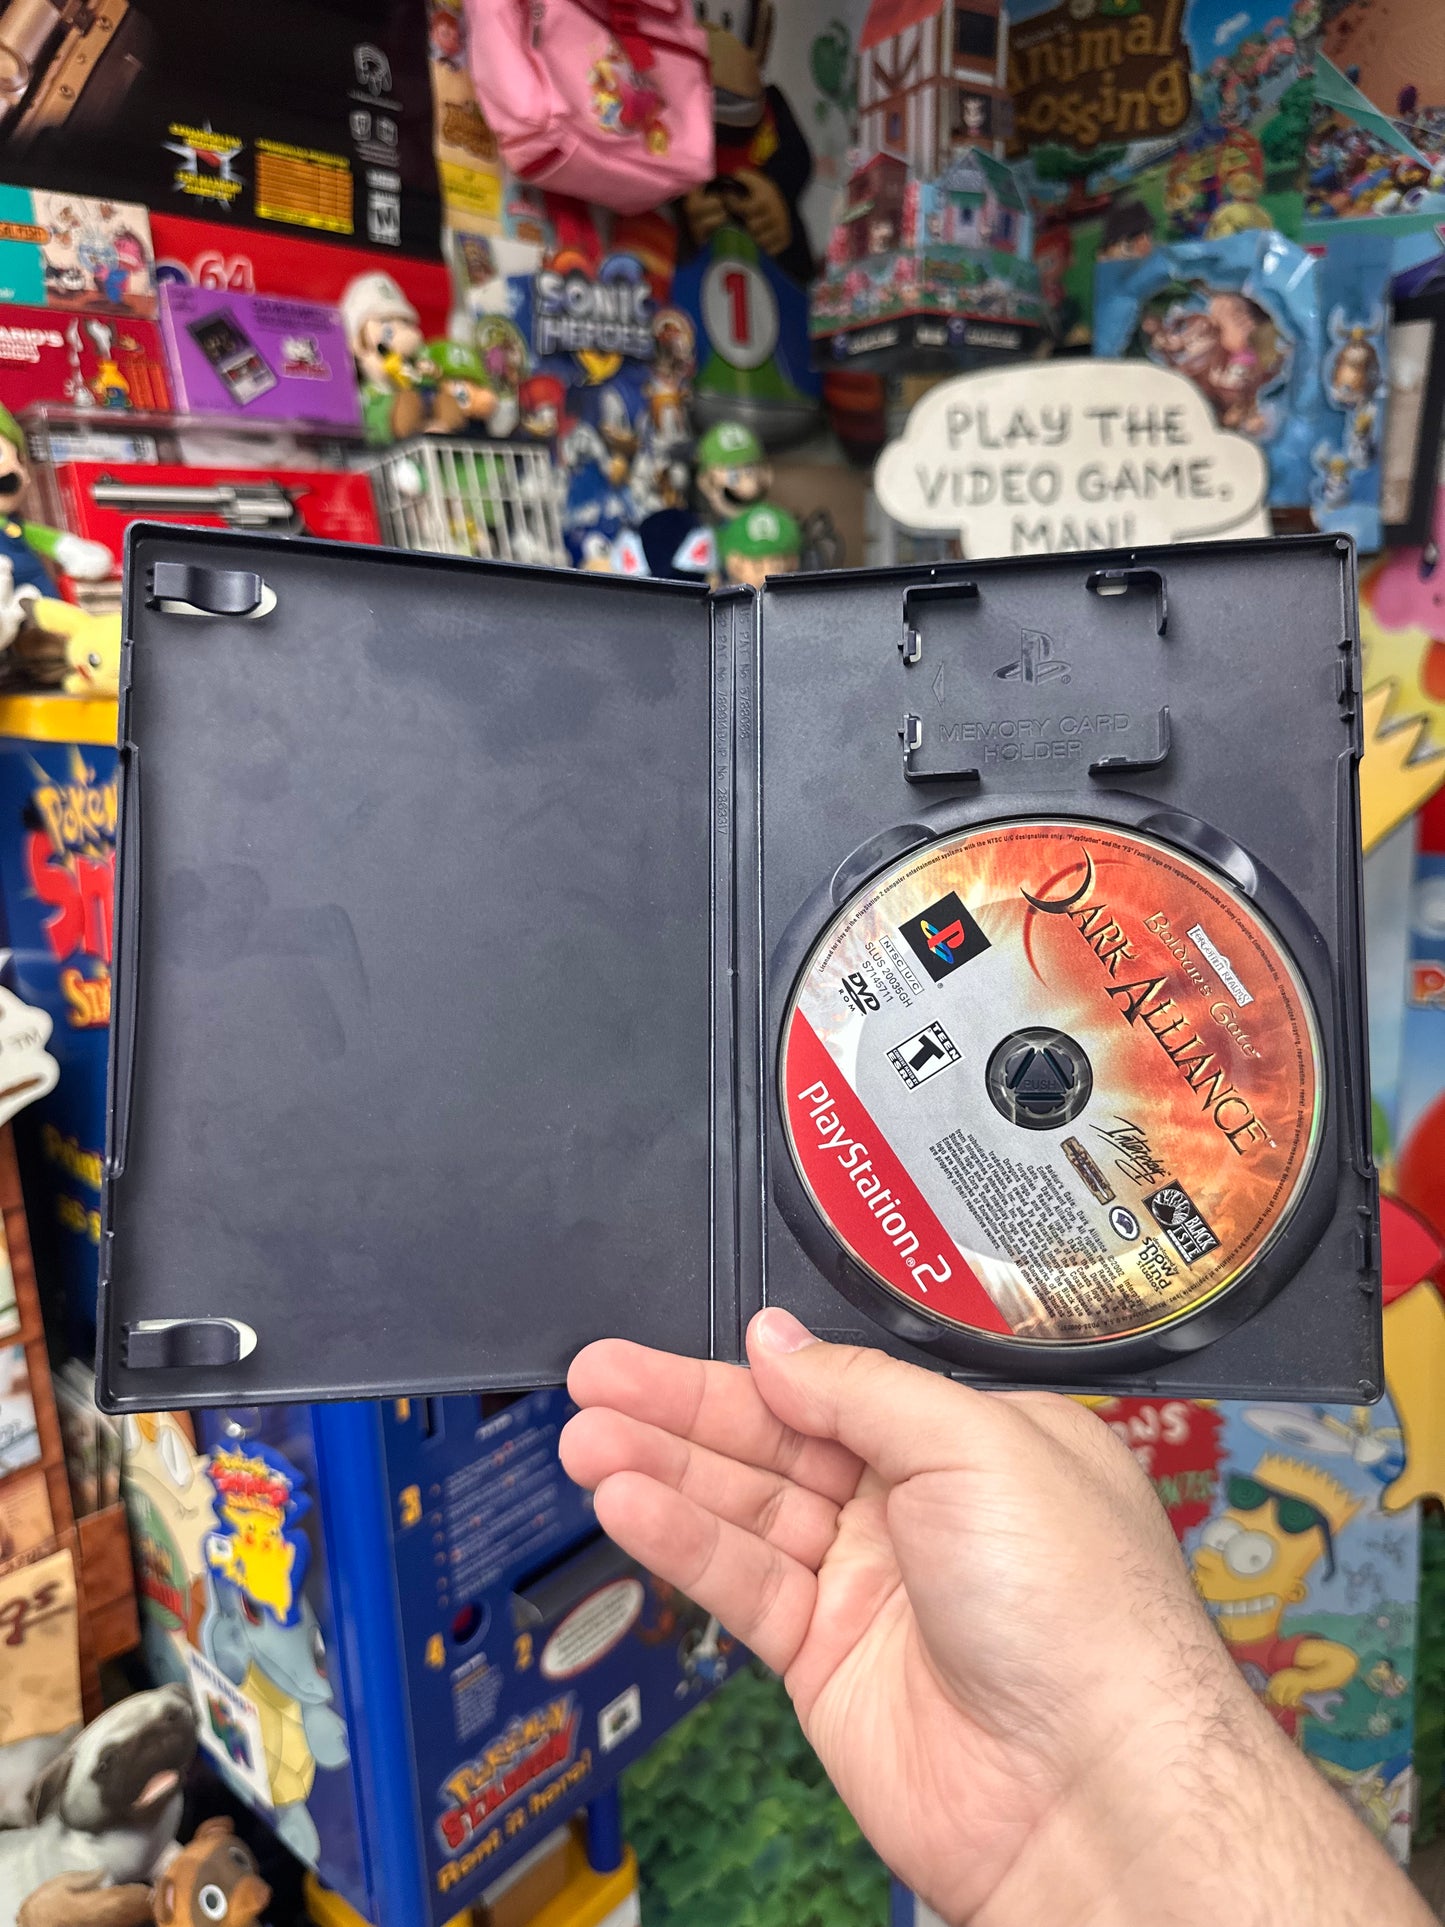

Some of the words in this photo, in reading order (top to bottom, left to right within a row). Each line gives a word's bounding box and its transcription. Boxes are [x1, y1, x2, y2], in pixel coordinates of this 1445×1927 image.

[1012, 58, 1188, 146] ossing
[536, 271, 653, 320] SONIC
[945, 402, 1072, 450] PLAY
[1083, 402, 1192, 448] THE
[915, 462, 1062, 508] VIDEO
[938, 719, 1052, 743] MEMORY
[1058, 713, 1130, 736] CARD
[983, 739, 1083, 763] HOLDER
[817, 949, 834, 973] Licensed
[830, 941, 839, 951] for
[835, 931, 847, 944] play
[848, 917, 858, 927] the
[854, 893, 881, 919] PlayStation
[882, 874, 906, 894] computer
[904, 854, 941, 878] entertainment
[940, 846, 963, 860] systems
[962, 842, 976, 851] with
[975, 839, 986, 847] the
[986, 835, 1003, 845] NTSC
[1014, 831, 1048, 841] designation
[1100, 838, 1112, 847] and
[1111, 841, 1121, 849] the
[1150, 856, 1164, 867] logo
[1162, 863, 1172, 871] are
[1170, 867, 1197, 886] registered
[1194, 882, 1222, 905] trademarks
[862, 960, 894, 1003] S7145711
[865, 942, 886, 968] SLUS
[882, 967, 913, 1008] 20035GH
[884, 941, 905, 968] NTSC
[904, 970, 920, 991] U/C
[838, 989, 856, 1012] ROM
[848, 972, 881, 1011] DVD
[1020, 846, 1139, 980] DARK
[1104, 976, 1270, 1156] ALLIANCE
[15, 1030, 42, 1048] TM
[909, 1034, 945, 1071] T
[932, 1023, 960, 1060] TEEN
[887, 1052, 915, 1089] ESRB
[1024, 1080, 1055, 1089] PUSH
[1089, 1115, 1167, 1186] Interplay
[933, 1154, 954, 1180] property
[954, 1184, 968, 1200] their
[962, 1197, 987, 1229] respective
[982, 1227, 1002, 1252] owners.
[941, 1136, 971, 1176] Entertainment
[965, 1174, 981, 1192] Corp.
[977, 1190, 1001, 1222] Snowblind
[997, 1220, 1016, 1244] Studios
[1026, 1263, 1051, 1296] Snowblind
[1046, 1294, 1066, 1318] Studios
[947, 1132, 966, 1155] Studios
[987, 1193, 1010, 1222] Interplay
[1025, 1247, 1051, 1282] trademarks
[1052, 1290, 1075, 1318] Interplay
[962, 1142, 989, 1176] Infogrames
[1016, 1220, 1031, 1238] Black
[1060, 1286, 1076, 1304] Black
[965, 1132, 990, 1164] subsidiary
[1045, 1250, 1067, 1278] Interplay
[1063, 1275, 1078, 1295] under
[987, 1149, 1013, 1184] trademarks
[1011, 1185, 1028, 1207] owned
[1034, 1219, 1054, 1245] Wizards
[1068, 1270, 1084, 1289] Coast
[1001, 1157, 1022, 1184] Dragons
[1046, 1222, 1066, 1248] Wizards
[1075, 1266, 1093, 1288] Coasts
[1035, 1165, 1066, 1207] Entertainment
[1063, 1205, 1078, 1224] Corp.
[1082, 1234, 1099, 1254] rights
[1095, 1253, 1119, 1283] reserved.
[1044, 1163, 1065, 1190] Baldur's
[1087, 1226, 1109, 1253] Alliance
[1106, 1253, 1125, 1277] ©2002
[950, 1164, 976, 1198] trademarks
[976, 1203, 1001, 1235] Snowblind
[1019, 1267, 1034, 1285] other
[1030, 1283, 1057, 1319] trademarks
[1013, 1161, 1037, 1192] Forgotten
[1035, 1192, 1055, 1217] Realms
[1088, 1271, 1113, 1304] Dungeons
[1073, 1235, 1098, 1267] Forgotten
[1142, 1236, 1178, 1277] snow
[1152, 1237, 1175, 1267] developed
[1174, 1226, 1200, 1258] ISLE
[1185, 1215, 1217, 1250] BLACK
[1138, 1250, 1171, 1289] blind
[400, 1484, 422, 1528] 3
